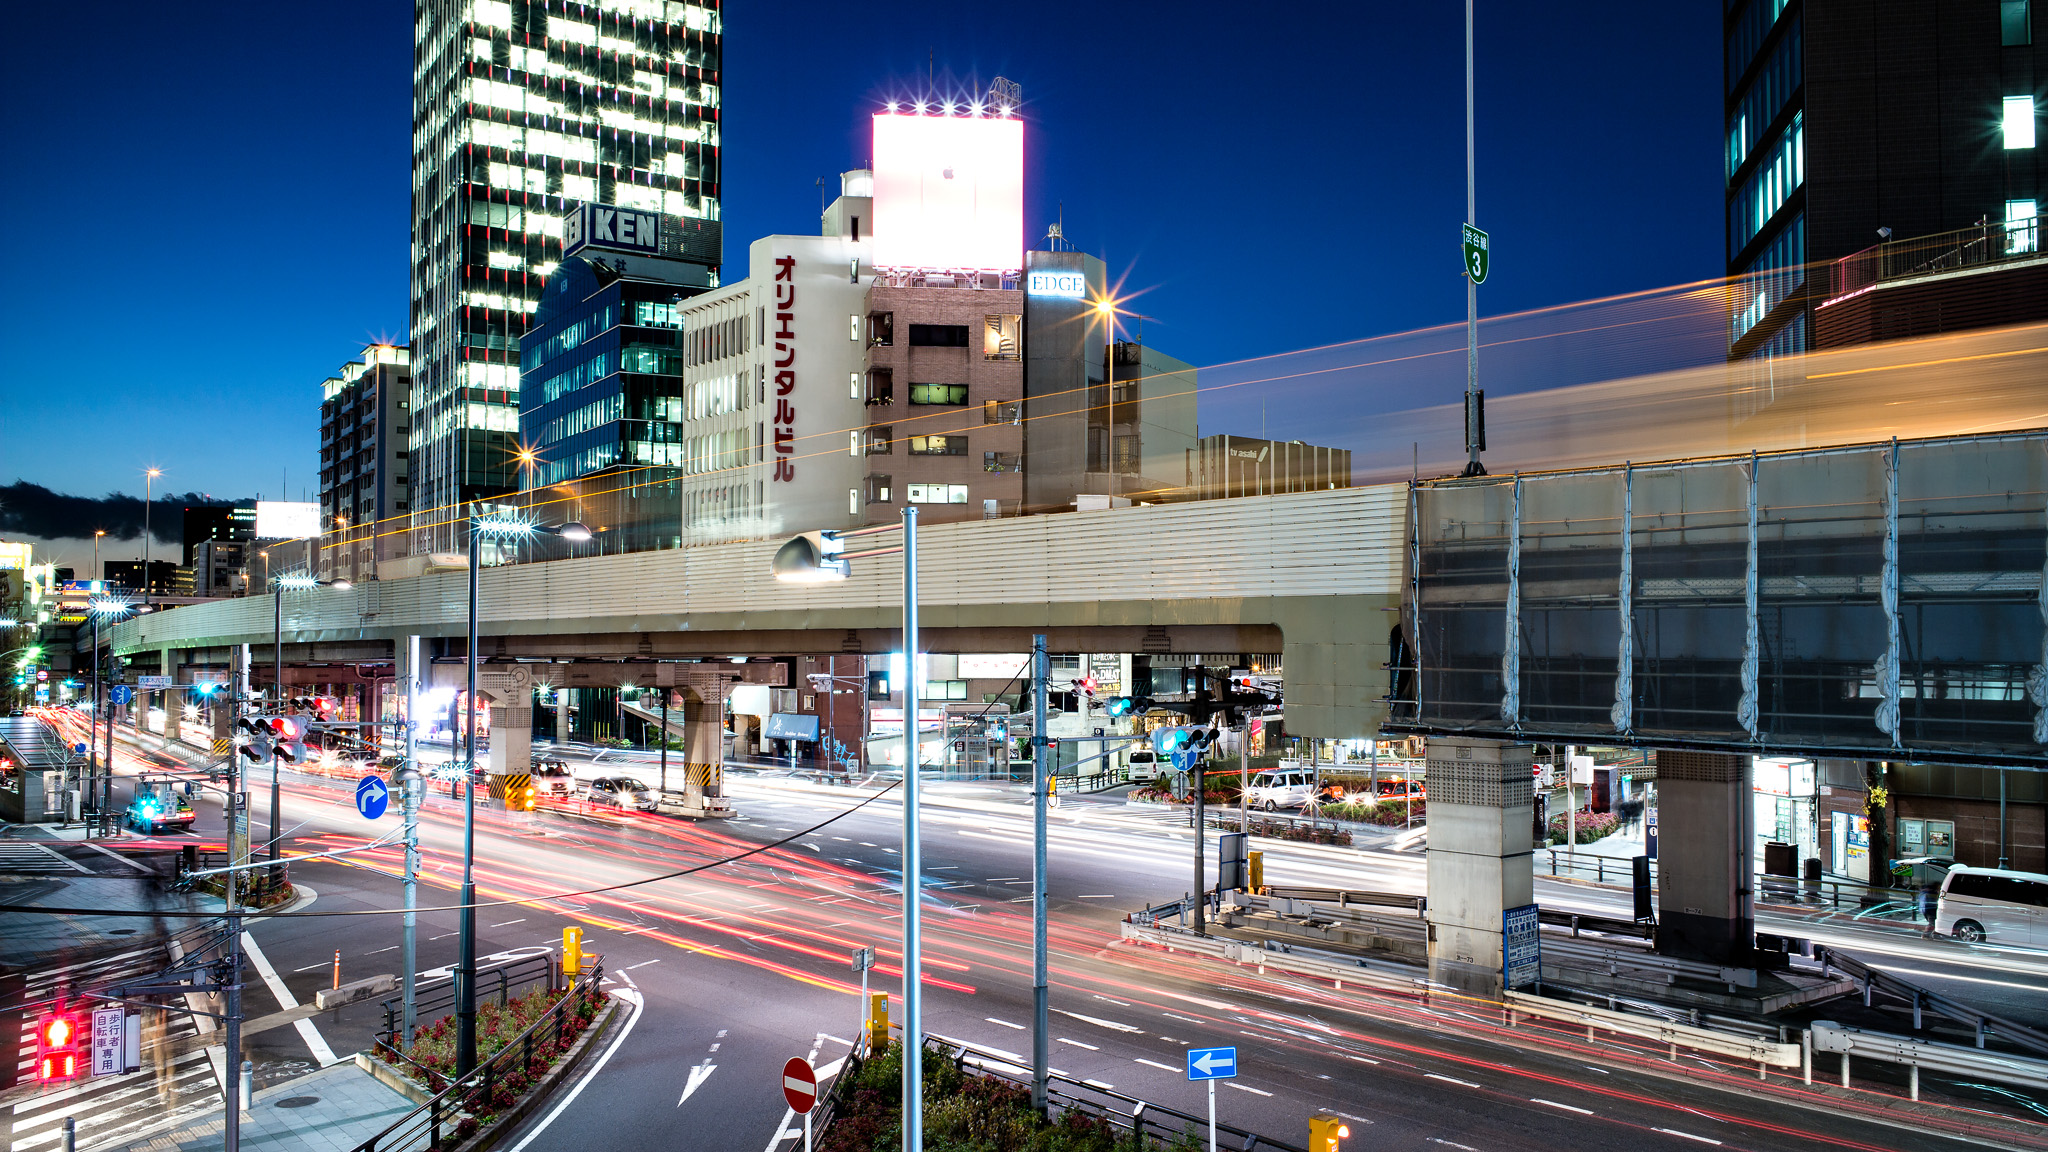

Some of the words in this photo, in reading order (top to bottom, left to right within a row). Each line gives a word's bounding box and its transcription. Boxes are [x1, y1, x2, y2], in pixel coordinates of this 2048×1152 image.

[595, 208, 655, 247] KEN
[1465, 229, 1487, 250] 渋谷線
[1472, 251, 1481, 277] 3
[1033, 276, 1083, 292] EDGE
[773, 255, 796, 482] オリエンタルビル
[1230, 448, 1238, 456] tv
[1238, 450, 1257, 459] asahi
[1510, 931, 1535, 943] 行っています
[96, 1015, 107, 1048] 自転車
[108, 1014, 120, 1047] 歩行者
[101, 1048, 113, 1070] 専用
